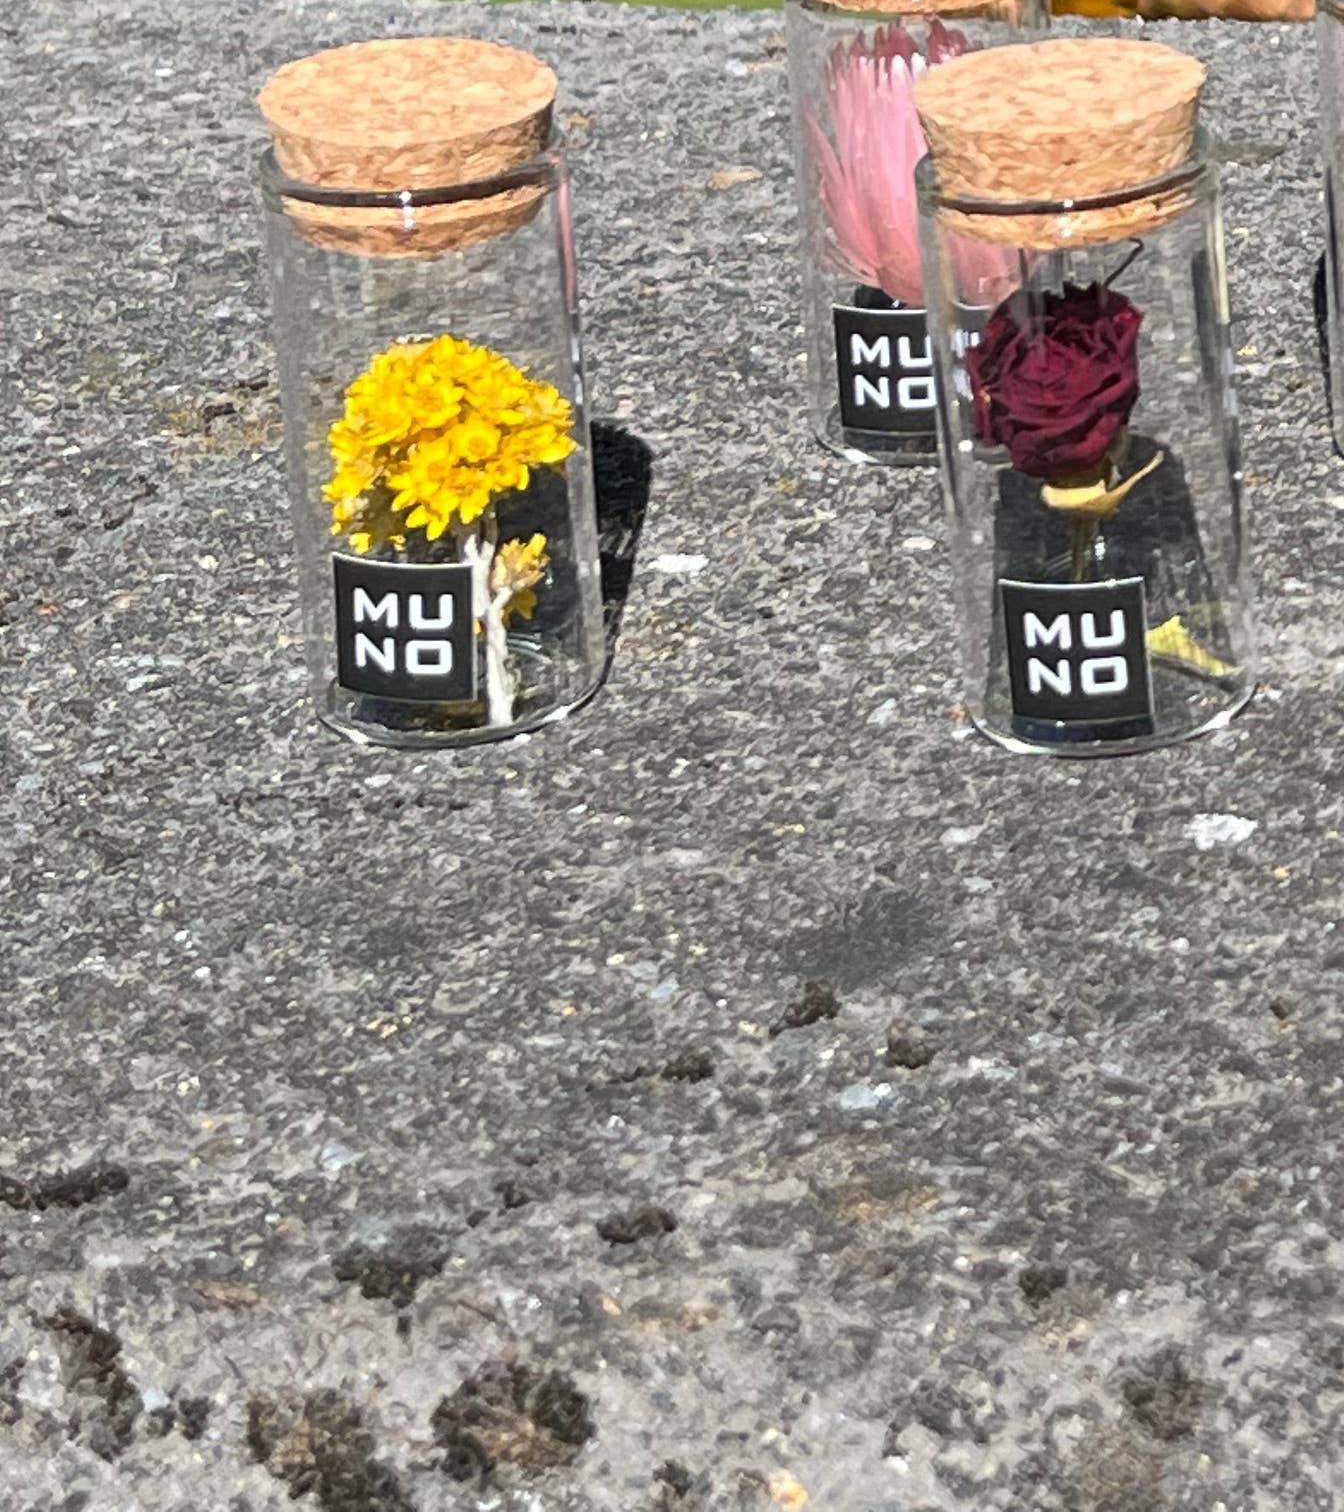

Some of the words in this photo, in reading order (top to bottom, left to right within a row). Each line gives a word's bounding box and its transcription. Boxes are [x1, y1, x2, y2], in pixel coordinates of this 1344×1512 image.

[850, 333, 934, 368] MU
[854, 374, 938, 409] NO
[353, 587, 453, 630] MU
[1023, 609, 1126, 650] MU
[355, 633, 453, 676] NO
[1028, 656, 1129, 695] NO
